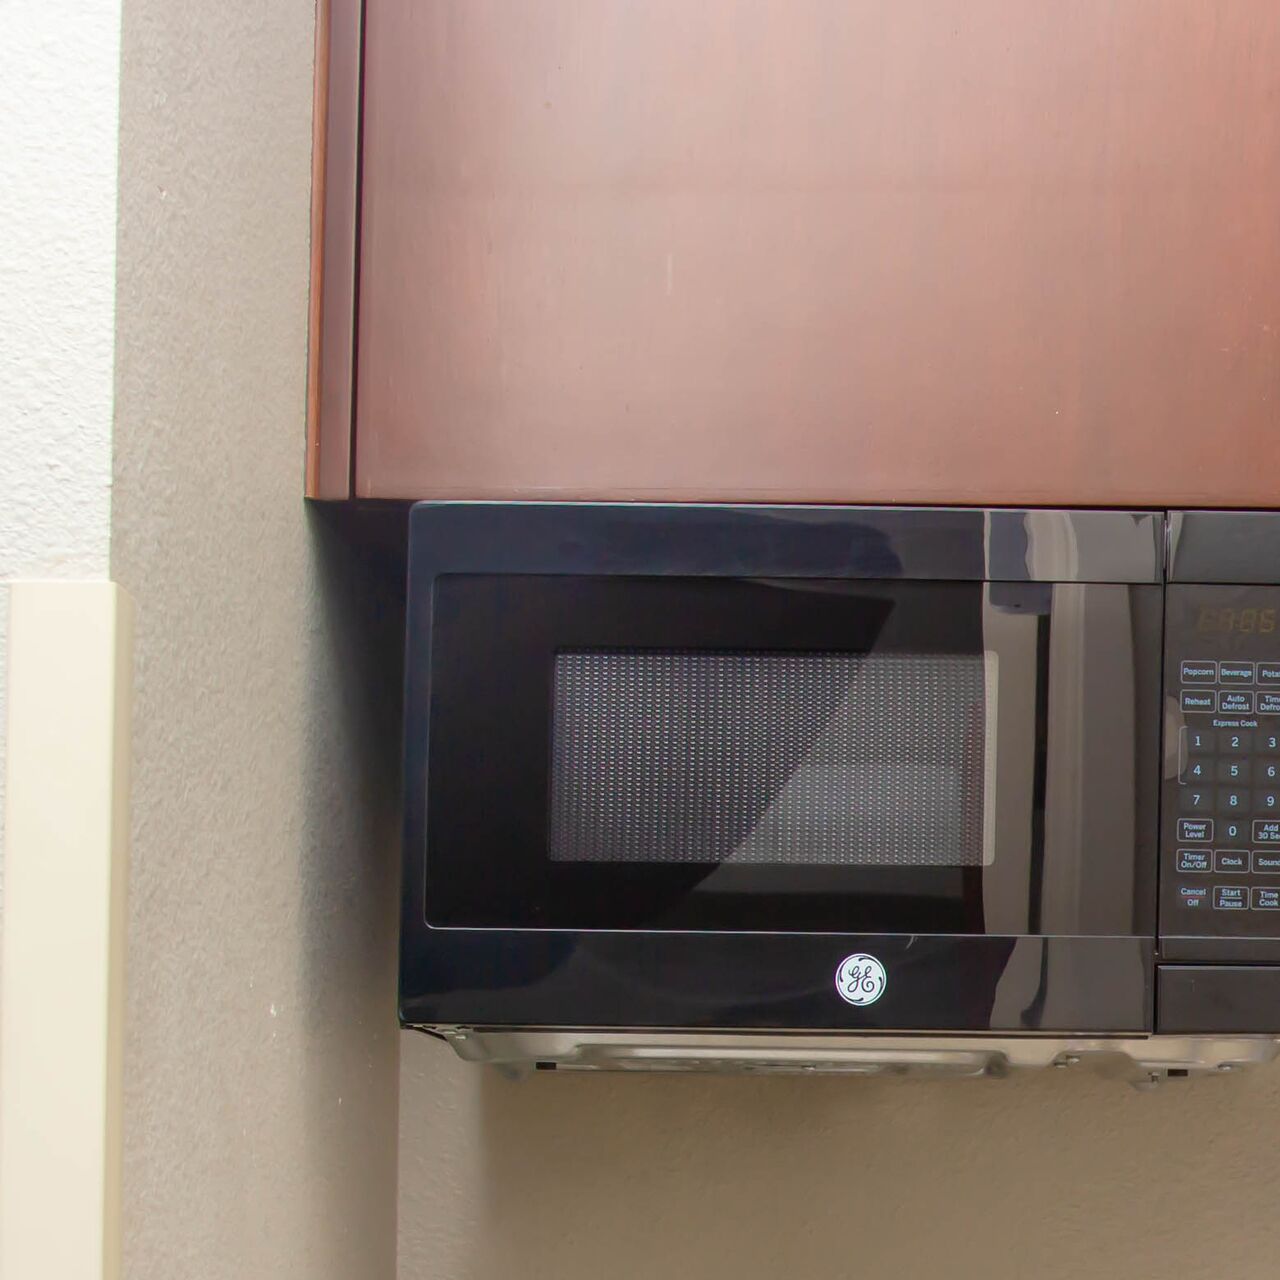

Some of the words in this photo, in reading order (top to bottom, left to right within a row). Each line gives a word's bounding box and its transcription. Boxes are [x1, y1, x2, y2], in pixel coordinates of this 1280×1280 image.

[1183, 667, 1215, 677] Popcorn
[1221, 668, 1252, 678] Beverage
[1184, 697, 1211, 705] Reheat
[1222, 702, 1249, 710] Defrost
[1213, 720, 1239, 728] Express
[1195, 736, 1201, 746] 1
[1231, 736, 1239, 747] 2
[1268, 737, 1276, 748] 3
[1193, 765, 1201, 775] 4
[1230, 765, 1238, 776] 5
[1267, 766, 1276, 777] 6
[1193, 795, 1200, 805] 7
[1230, 795, 1237, 806] 8
[1266, 796, 1275, 807] 9
[1183, 822, 1206, 830] Power
[1228, 826, 1237, 836] 0
[1181, 861, 1207, 869] On/Off
[1221, 857, 1242, 865] Clock
[1180, 887, 1206, 895] Cancel
[1221, 888, 1241, 896] Start
[1260, 890, 1279, 898] Time
[1187, 898, 1199, 906] Off
[1219, 899, 1243, 907] Pause
[1259, 899, 1279, 907] Cook
